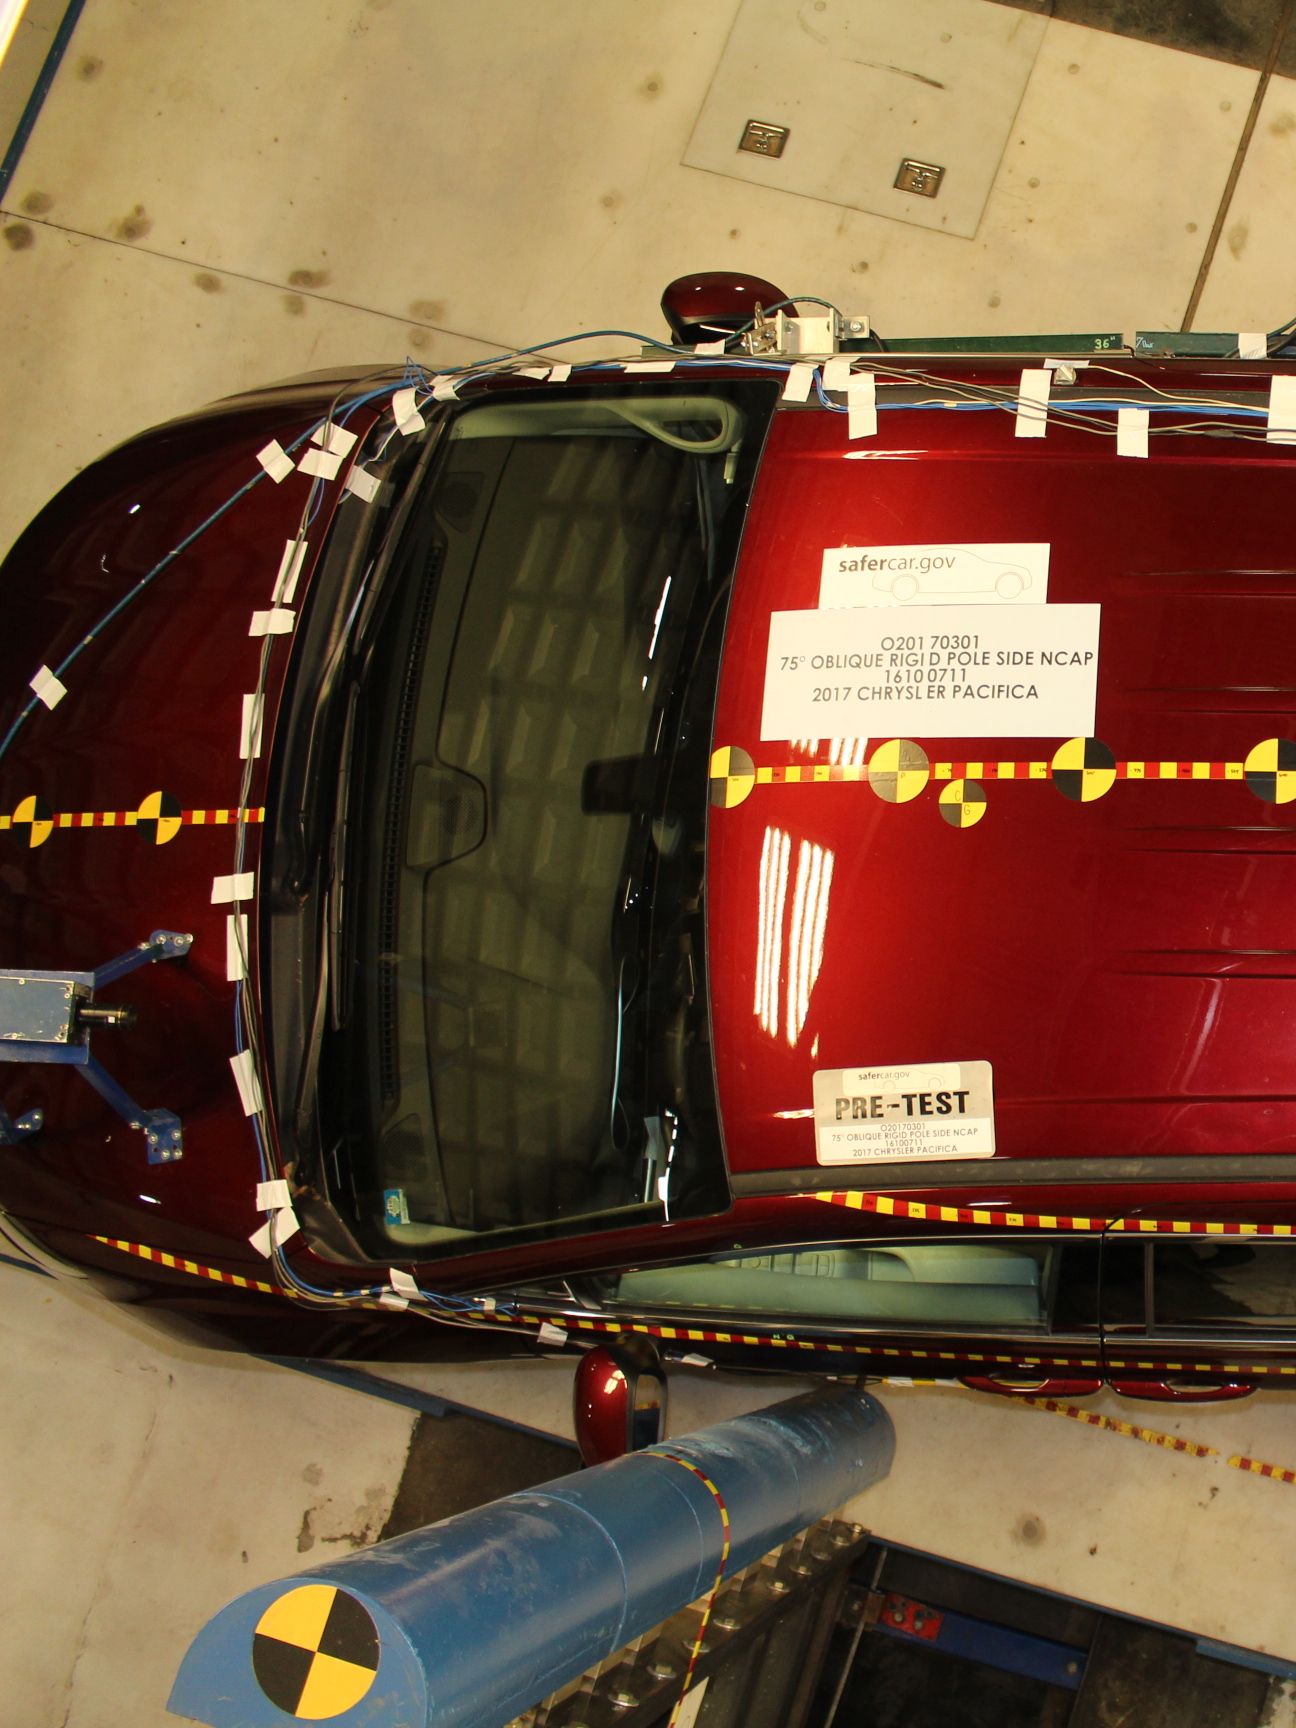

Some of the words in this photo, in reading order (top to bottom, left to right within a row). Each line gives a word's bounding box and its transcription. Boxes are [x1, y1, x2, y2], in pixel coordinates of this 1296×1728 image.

[838, 554, 956, 575] safercar.gov
[810, 653, 884, 670] OBLIQUE
[947, 651, 991, 666] POLE
[996, 650, 1035, 666] SIDE
[1040, 650, 1094, 666] NCAP
[812, 686, 852, 702] 2017
[952, 684, 1039, 700] PACIFICA
[963, 804, 971, 816] G
[858, 1071, 910, 1081] safercar.gov
[835, 1091, 970, 1120] PRE-TEST
[846, 1132, 882, 1142] OBLIQUE
[884, 1130, 908, 1140] RIGID
[909, 1129, 931, 1139] POLE
[932, 1128, 952, 1138] SIDE
[953, 1127, 979, 1137] NCAP
[852, 1148, 872, 1157] 2017
[873, 1145, 915, 1156] CHRYSLER
[916, 1144, 958, 1154] PACIFICA
[885, 1138, 923, 1148] 16100711
